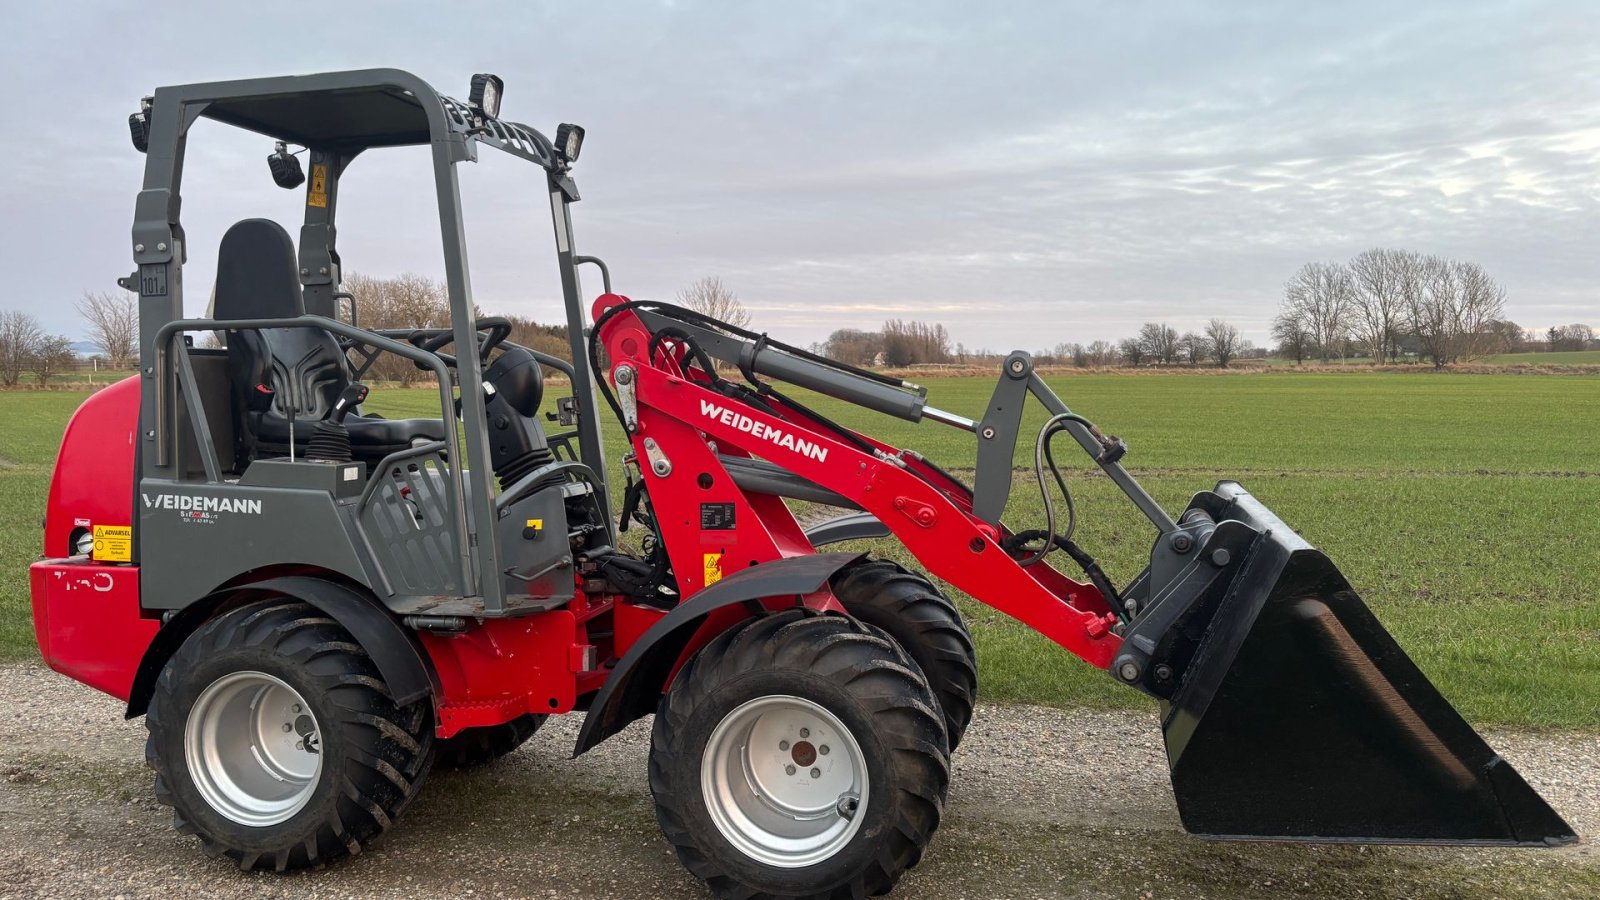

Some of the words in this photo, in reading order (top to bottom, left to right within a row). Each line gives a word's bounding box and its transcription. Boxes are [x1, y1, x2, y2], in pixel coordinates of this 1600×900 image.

[143, 277, 159, 294] 101
[700, 399, 828, 463] WEIDEMANN
[142, 493, 262, 515] WEIDEMANN
[105, 529, 131, 537] ADVARSEL
